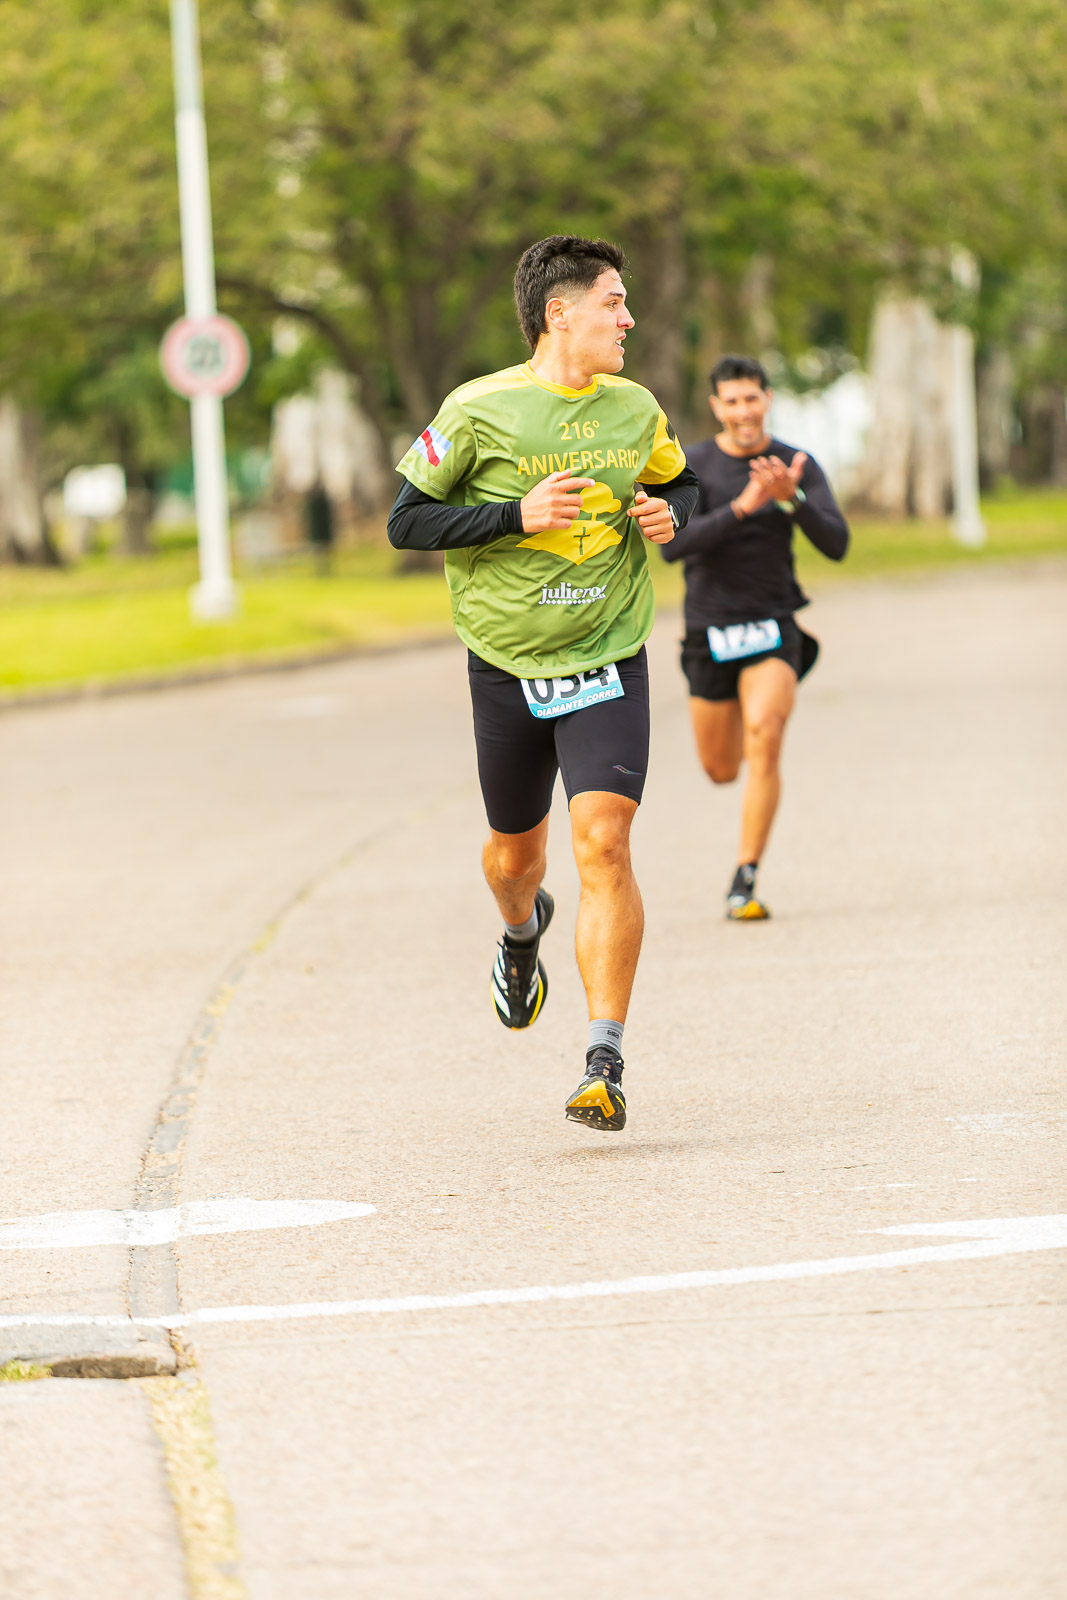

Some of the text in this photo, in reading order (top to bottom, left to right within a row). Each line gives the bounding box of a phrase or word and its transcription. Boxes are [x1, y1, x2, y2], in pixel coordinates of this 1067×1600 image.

[517, 449, 639, 476] ANIVERSARIO
[536, 688, 618, 717] DIAMANTE CORRE
